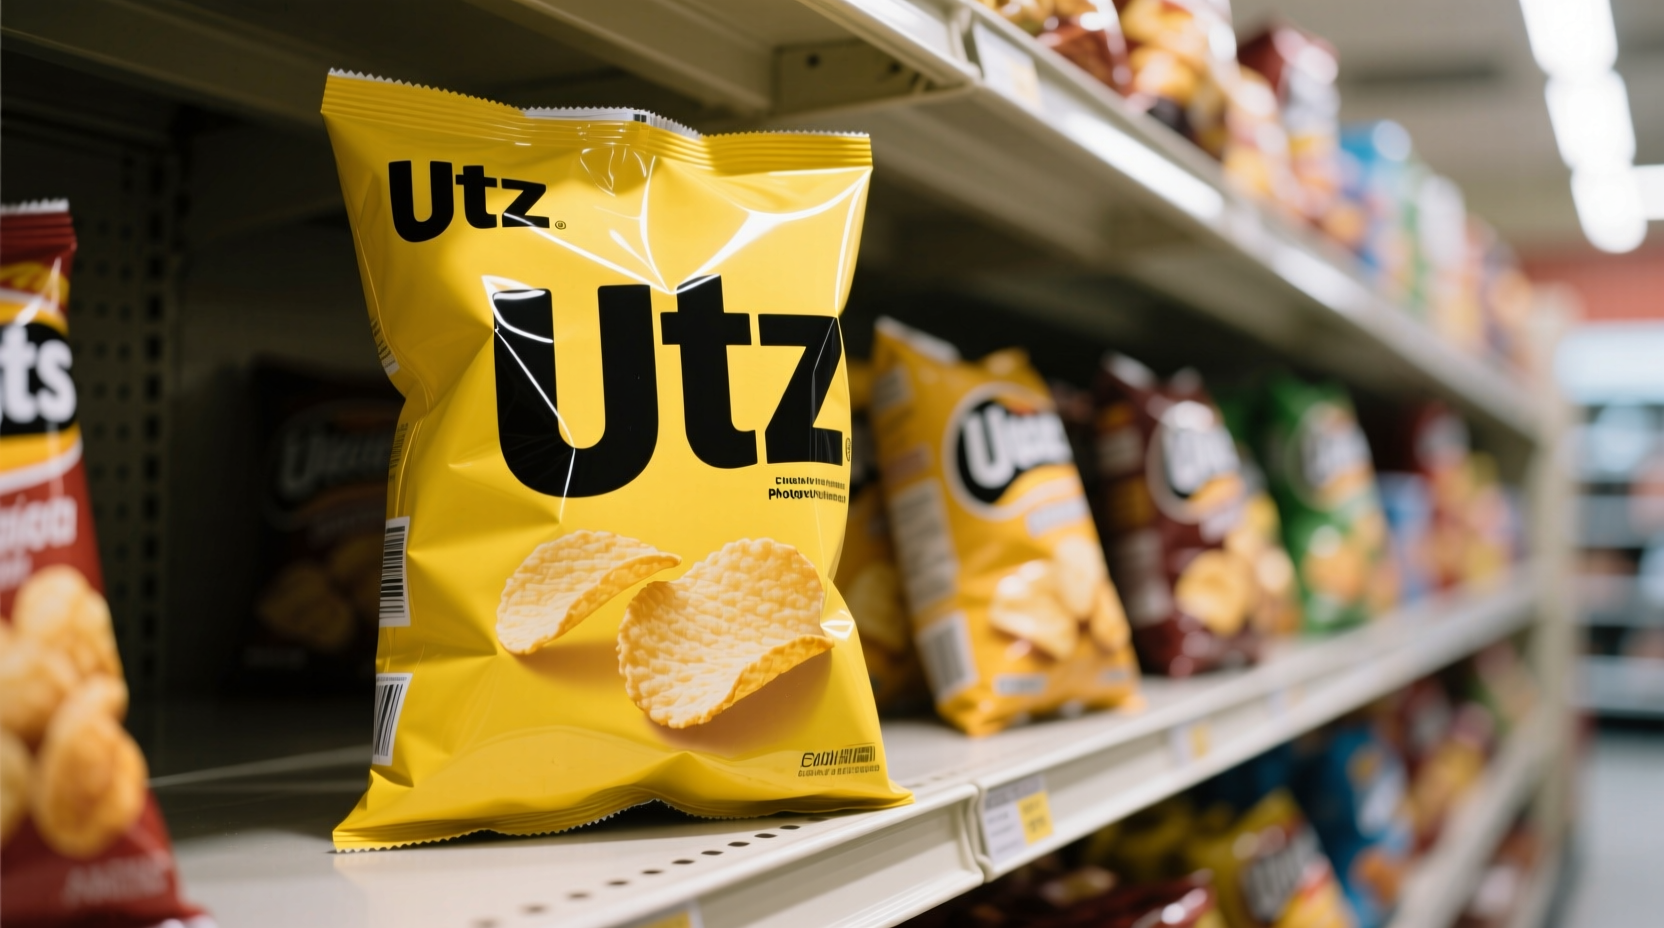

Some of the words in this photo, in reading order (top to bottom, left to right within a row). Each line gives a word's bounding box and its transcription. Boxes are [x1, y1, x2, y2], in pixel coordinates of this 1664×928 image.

[388, 160, 550, 243] Utz
[0, 324, 77, 422] ts
[493, 274, 843, 498] Utz
